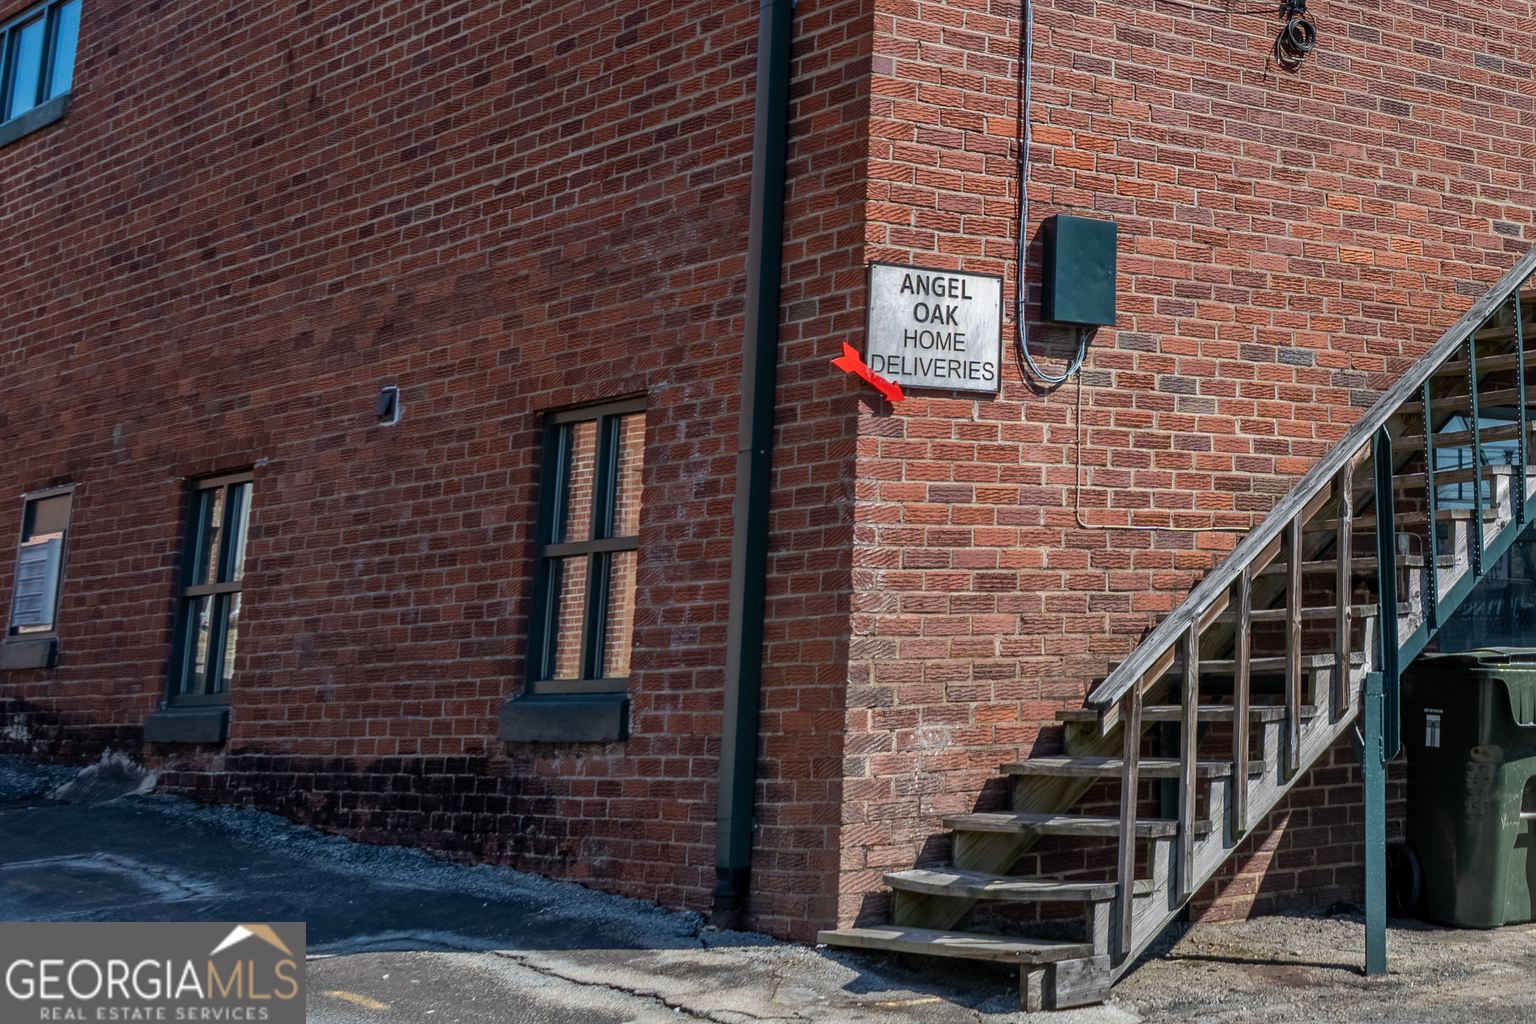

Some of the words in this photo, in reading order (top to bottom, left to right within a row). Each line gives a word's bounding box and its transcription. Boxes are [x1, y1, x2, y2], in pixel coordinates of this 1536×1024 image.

[900, 273, 972, 299] ANGEL
[913, 302, 958, 325] OAK
[903, 329, 966, 352] HOME
[871, 354, 995, 380] DELIVERIES
